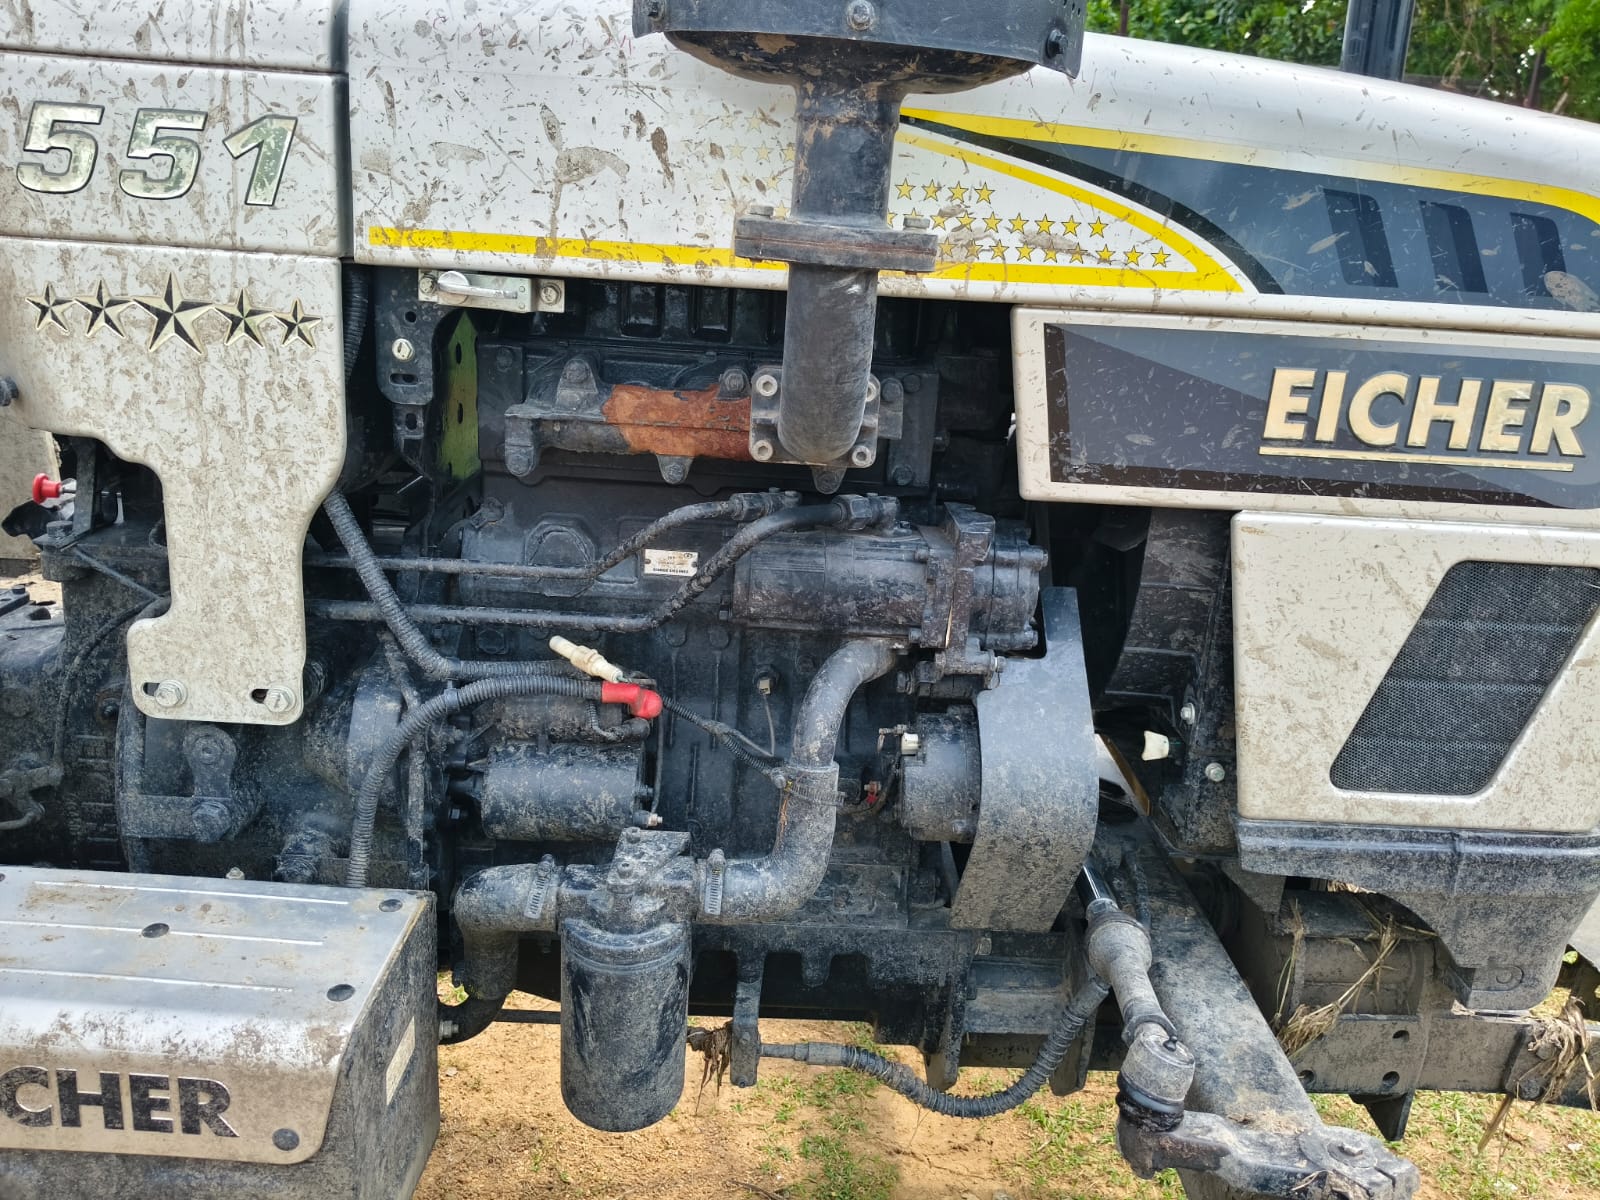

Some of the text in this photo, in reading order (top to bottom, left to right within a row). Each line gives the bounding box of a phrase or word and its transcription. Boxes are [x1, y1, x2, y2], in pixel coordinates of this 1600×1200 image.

[17, 101, 298, 206] 551
[1262, 367, 1592, 457] EICHER
[0, 1065, 240, 1138] CHER
